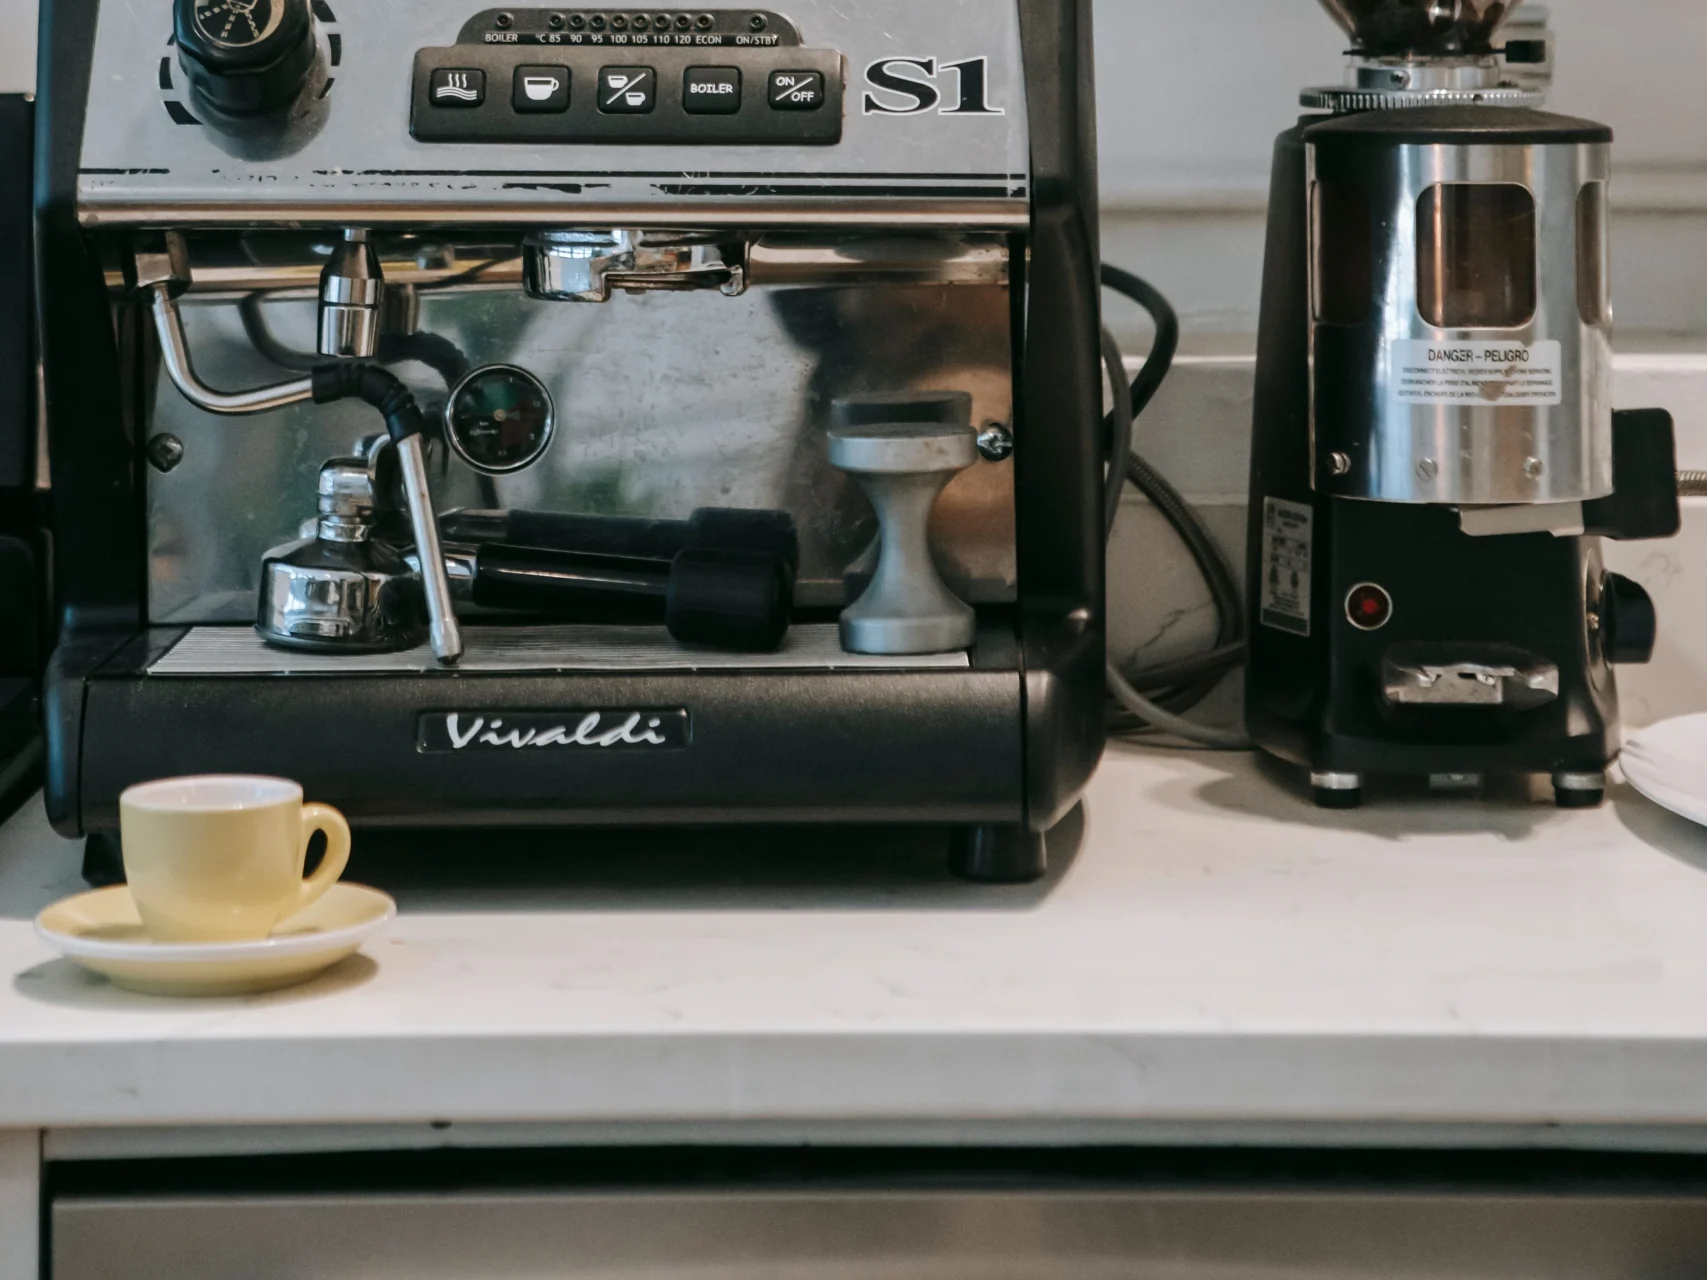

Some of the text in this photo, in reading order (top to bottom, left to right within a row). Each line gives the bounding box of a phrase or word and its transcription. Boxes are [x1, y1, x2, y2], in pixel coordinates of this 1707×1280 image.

[485, 33, 518, 42] BOILER
[549, 34, 561, 43] 85
[570, 34, 582, 43] 90
[591, 34, 603, 43] 95
[611, 34, 628, 44] 100
[631, 34, 648, 44] 105
[653, 35, 670, 44] 110
[674, 35, 691, 44] 120
[696, 35, 722, 45] ECON
[689, 83, 734, 94] BOILER
[861, 55, 1006, 116] S1
[791, 91, 815, 102] OFF
[1428, 349, 1474, 362] DANGER
[1484, 349, 1529, 362] PELIGRO
[446, 712, 666, 749] Vivaldi
